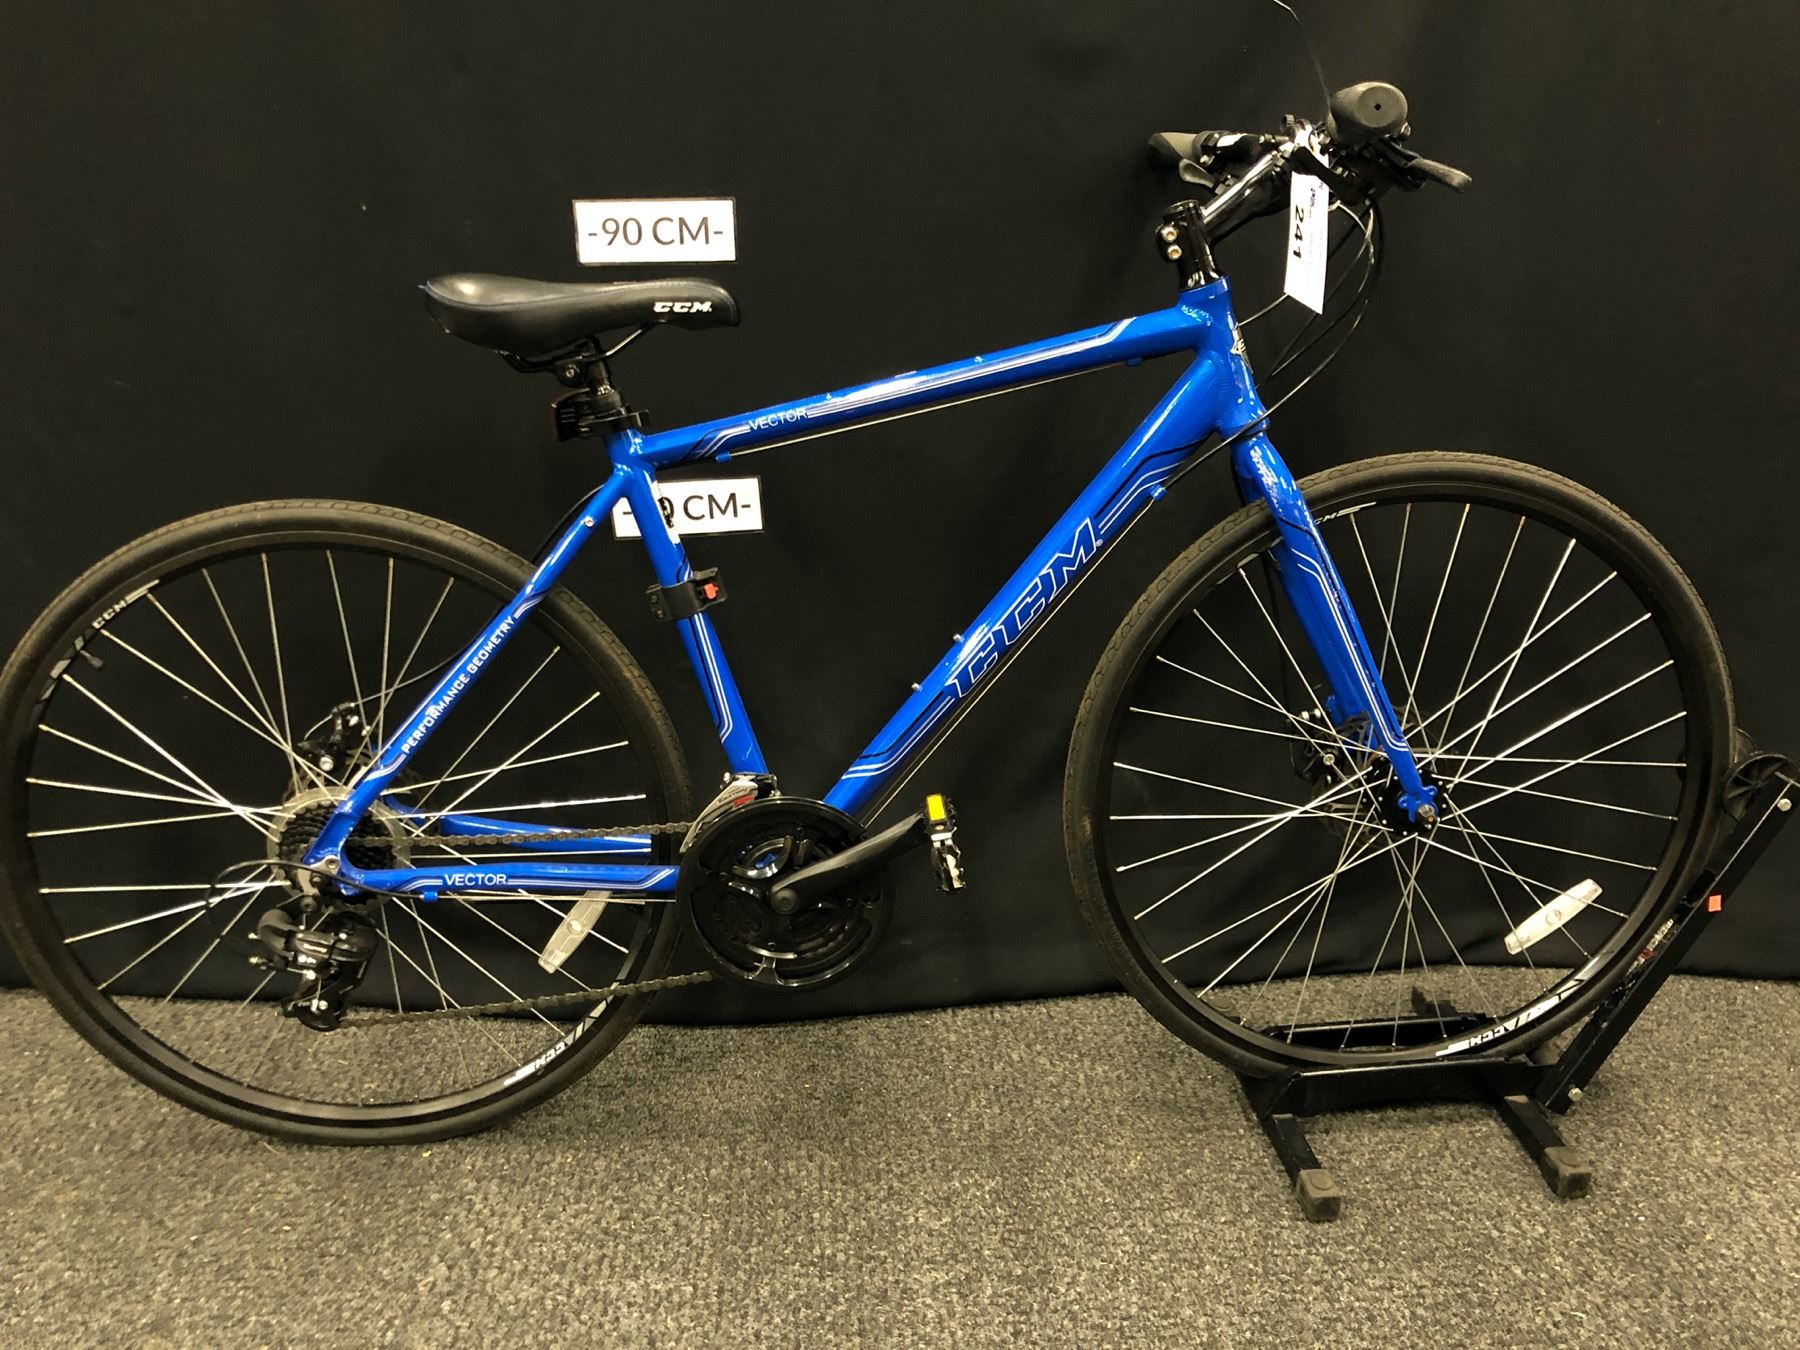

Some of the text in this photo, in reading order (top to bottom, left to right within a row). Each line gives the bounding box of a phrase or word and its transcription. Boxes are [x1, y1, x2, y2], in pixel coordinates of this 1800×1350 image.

[588, 216, 723, 246] -90 CM-
[1293, 204, 1304, 259] 241
[653, 301, 712, 313] CCM
[749, 408, 808, 431] VECTOR
[683, 492, 751, 521] CM-
[945, 517, 1098, 698] CCM
[400, 605, 515, 755] PERFORMANCE GEOMETRY
[444, 873, 507, 886] VECTOR
